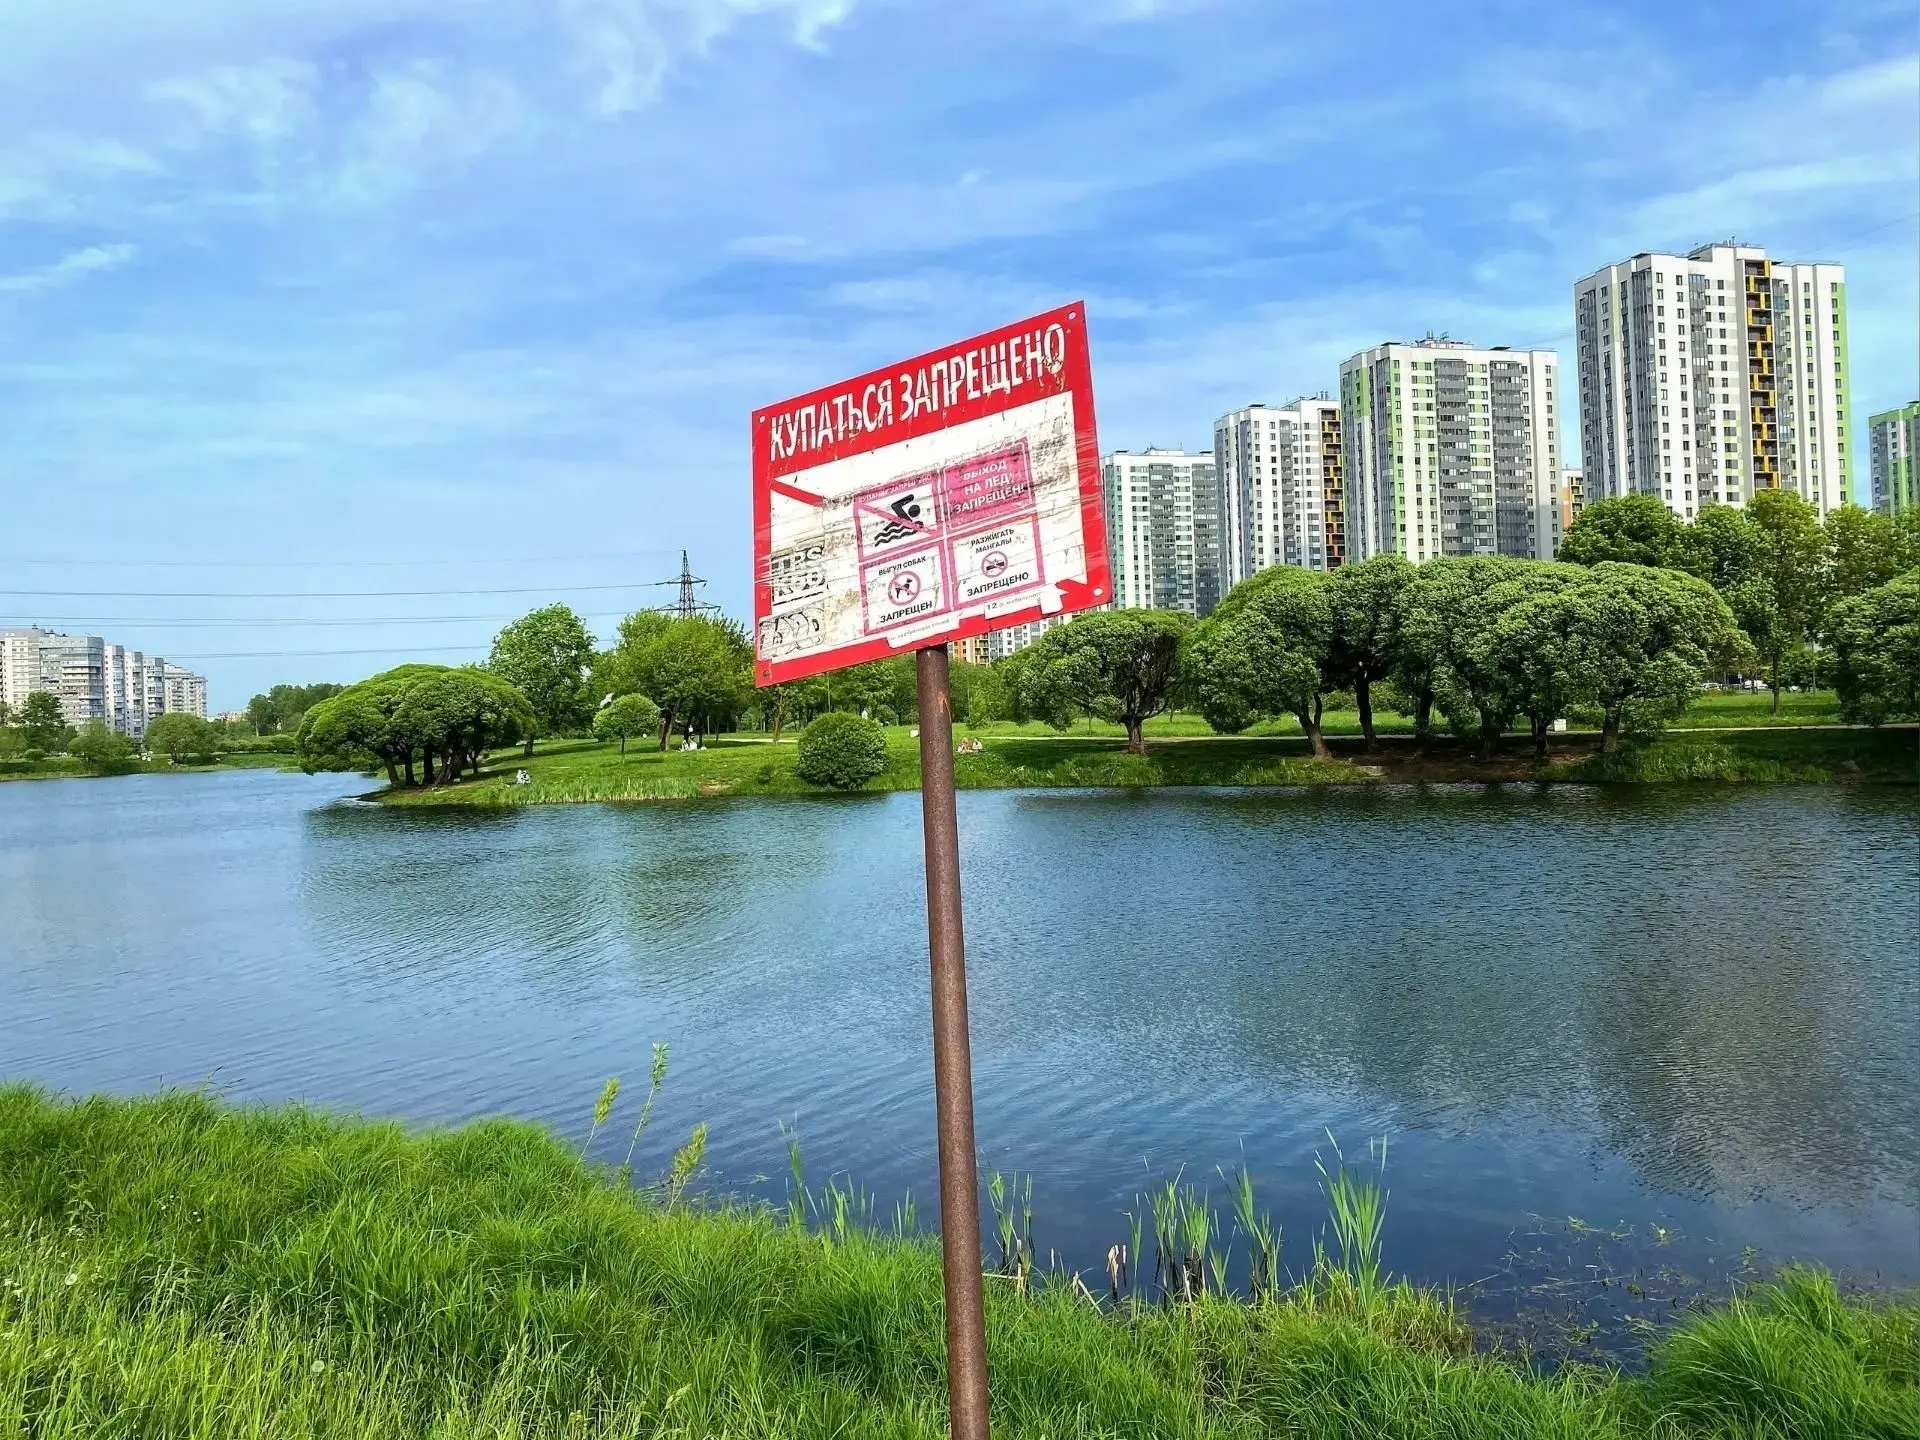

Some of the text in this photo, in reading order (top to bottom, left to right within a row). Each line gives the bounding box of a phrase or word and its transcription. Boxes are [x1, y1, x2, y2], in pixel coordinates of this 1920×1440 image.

[769, 322, 1066, 462] КУПАТЬСЯ ЗАПРЕЩЕНО
[964, 482, 982, 496] НА
[970, 527, 1015, 547] РАЗЖИГАТЬ
[975, 537, 1013, 554] МАНГАЛЫ
[878, 555, 927, 576] ВЫГУЛ СОБАК
[966, 571, 1029, 598] ЗАПРЕЩЕНО
[879, 600, 933, 624] ЗАПРЕЩЕН
